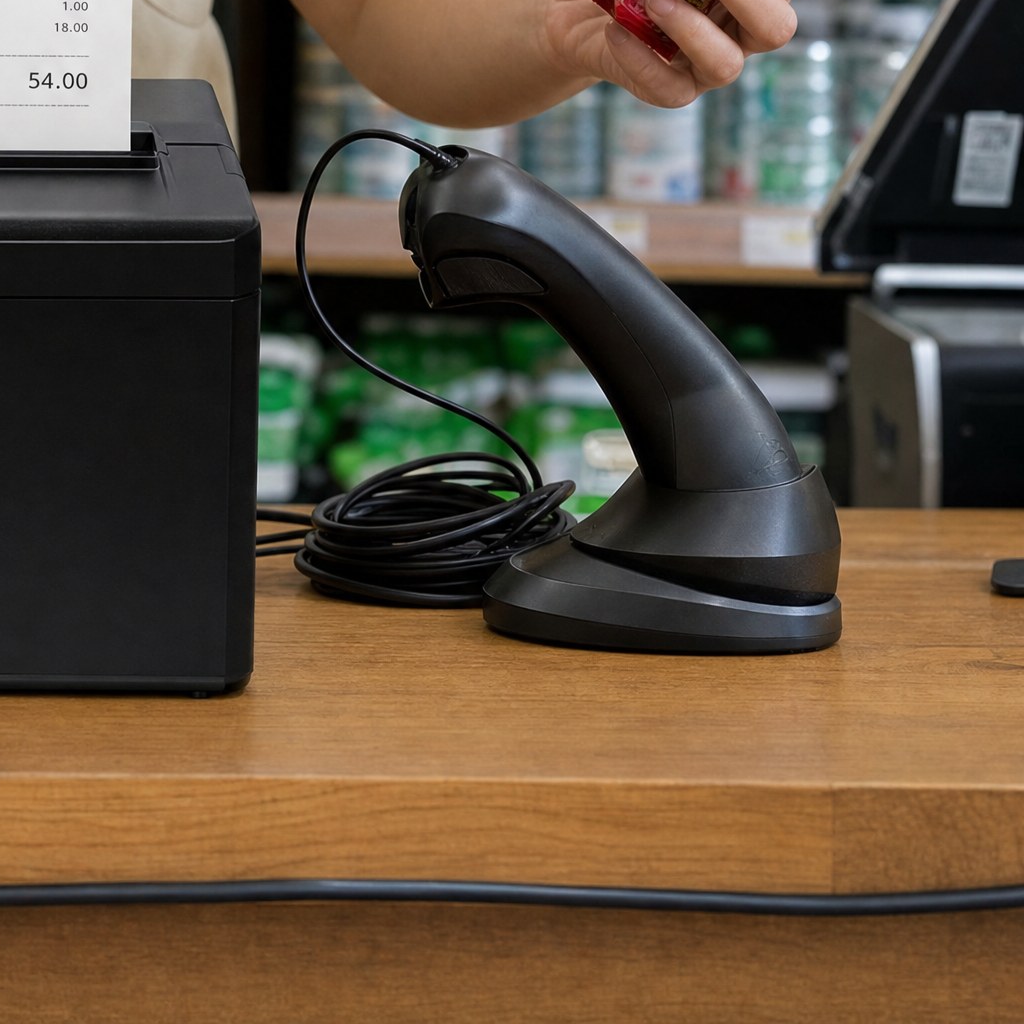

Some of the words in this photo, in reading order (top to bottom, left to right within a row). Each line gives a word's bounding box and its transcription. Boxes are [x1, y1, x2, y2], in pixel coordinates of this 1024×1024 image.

[62, 0, 88, 12] 1.00
[54, 22, 88, 33] 18.00
[28, 71, 87, 90] 54.00
